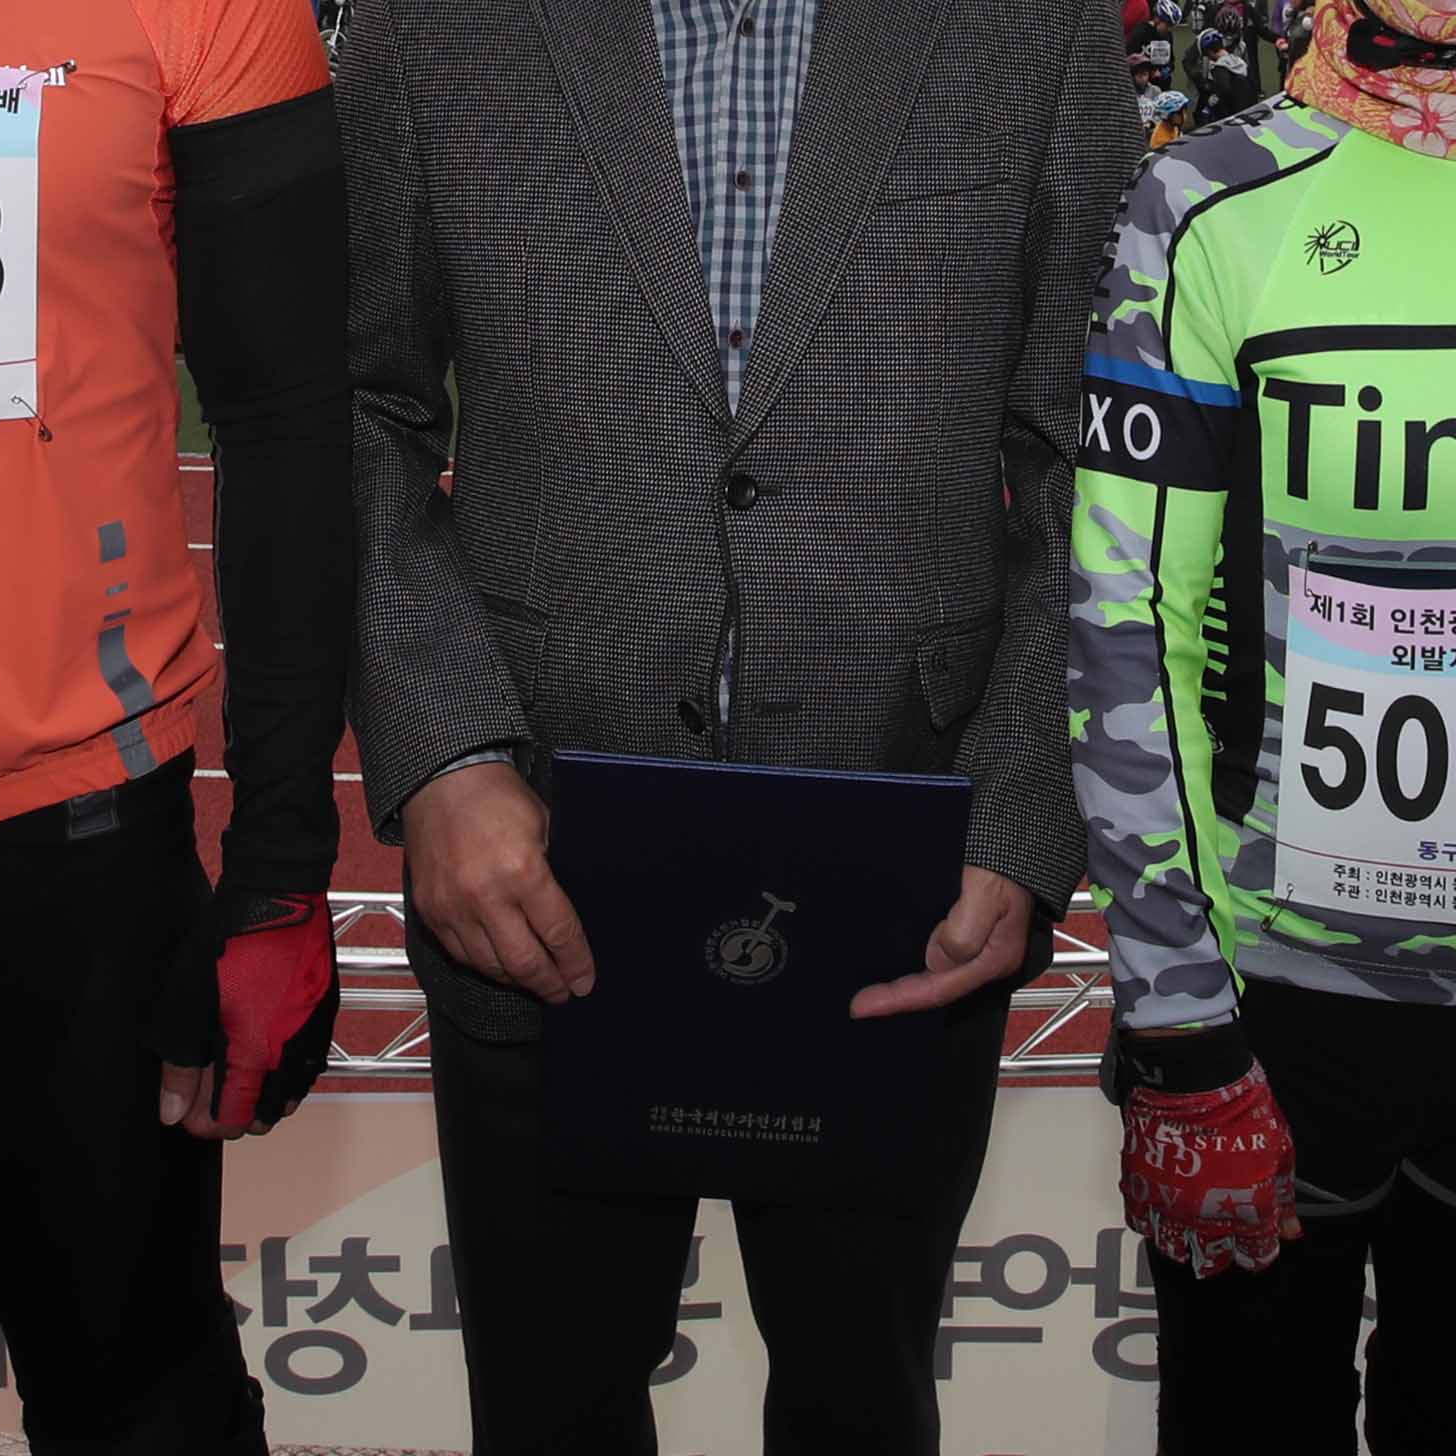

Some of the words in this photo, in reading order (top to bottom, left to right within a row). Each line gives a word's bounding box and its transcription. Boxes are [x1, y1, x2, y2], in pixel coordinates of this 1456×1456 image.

[1079, 391, 1163, 462] XO
[1309, 590, 1376, 630] 제1회
[1375, 869, 1447, 891] 인천광역시
[1374, 888, 1447, 910] 인천광역시
[1193, 1132, 1267, 1153] STAR
